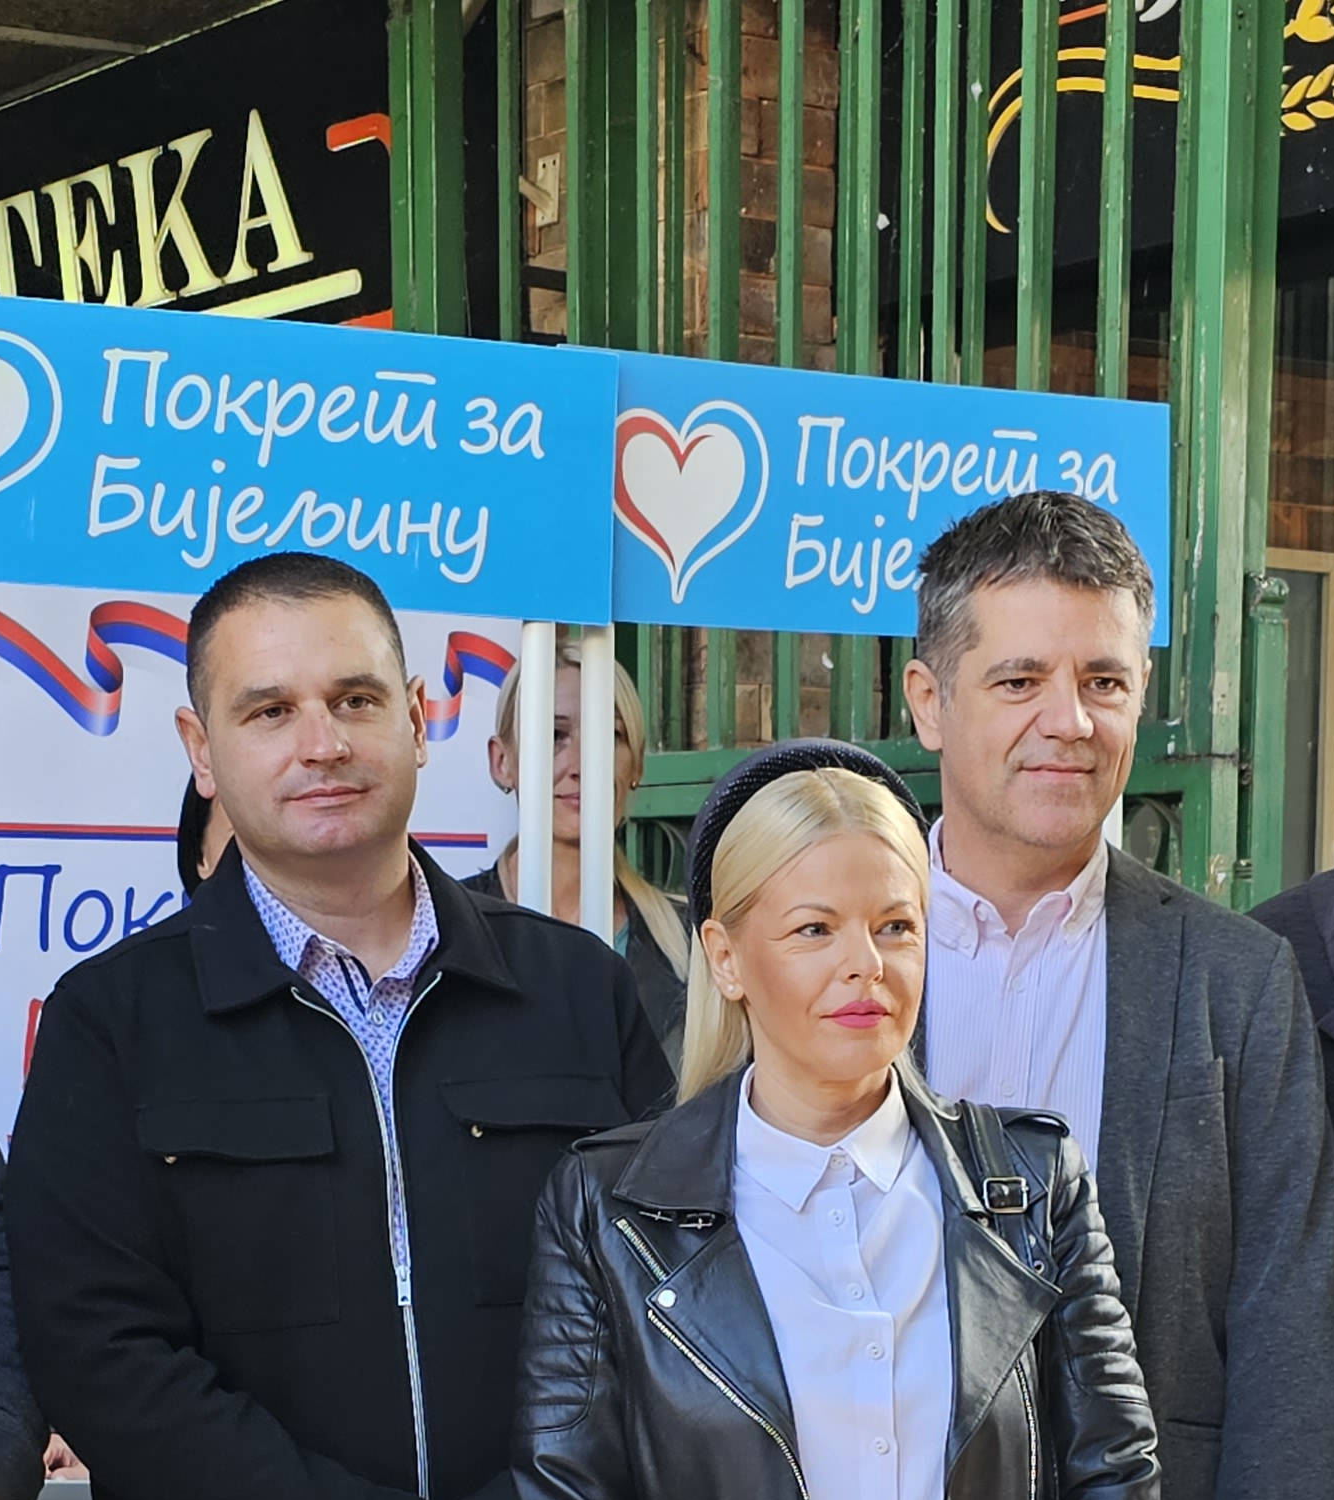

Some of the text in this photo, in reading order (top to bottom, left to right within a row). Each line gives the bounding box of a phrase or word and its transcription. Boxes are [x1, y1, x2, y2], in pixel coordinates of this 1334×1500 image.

[459, 397, 545, 459] за
[1058, 450, 1119, 504] за
[87, 454, 489, 583] Бијељину
[785, 513, 927, 614] Бије
